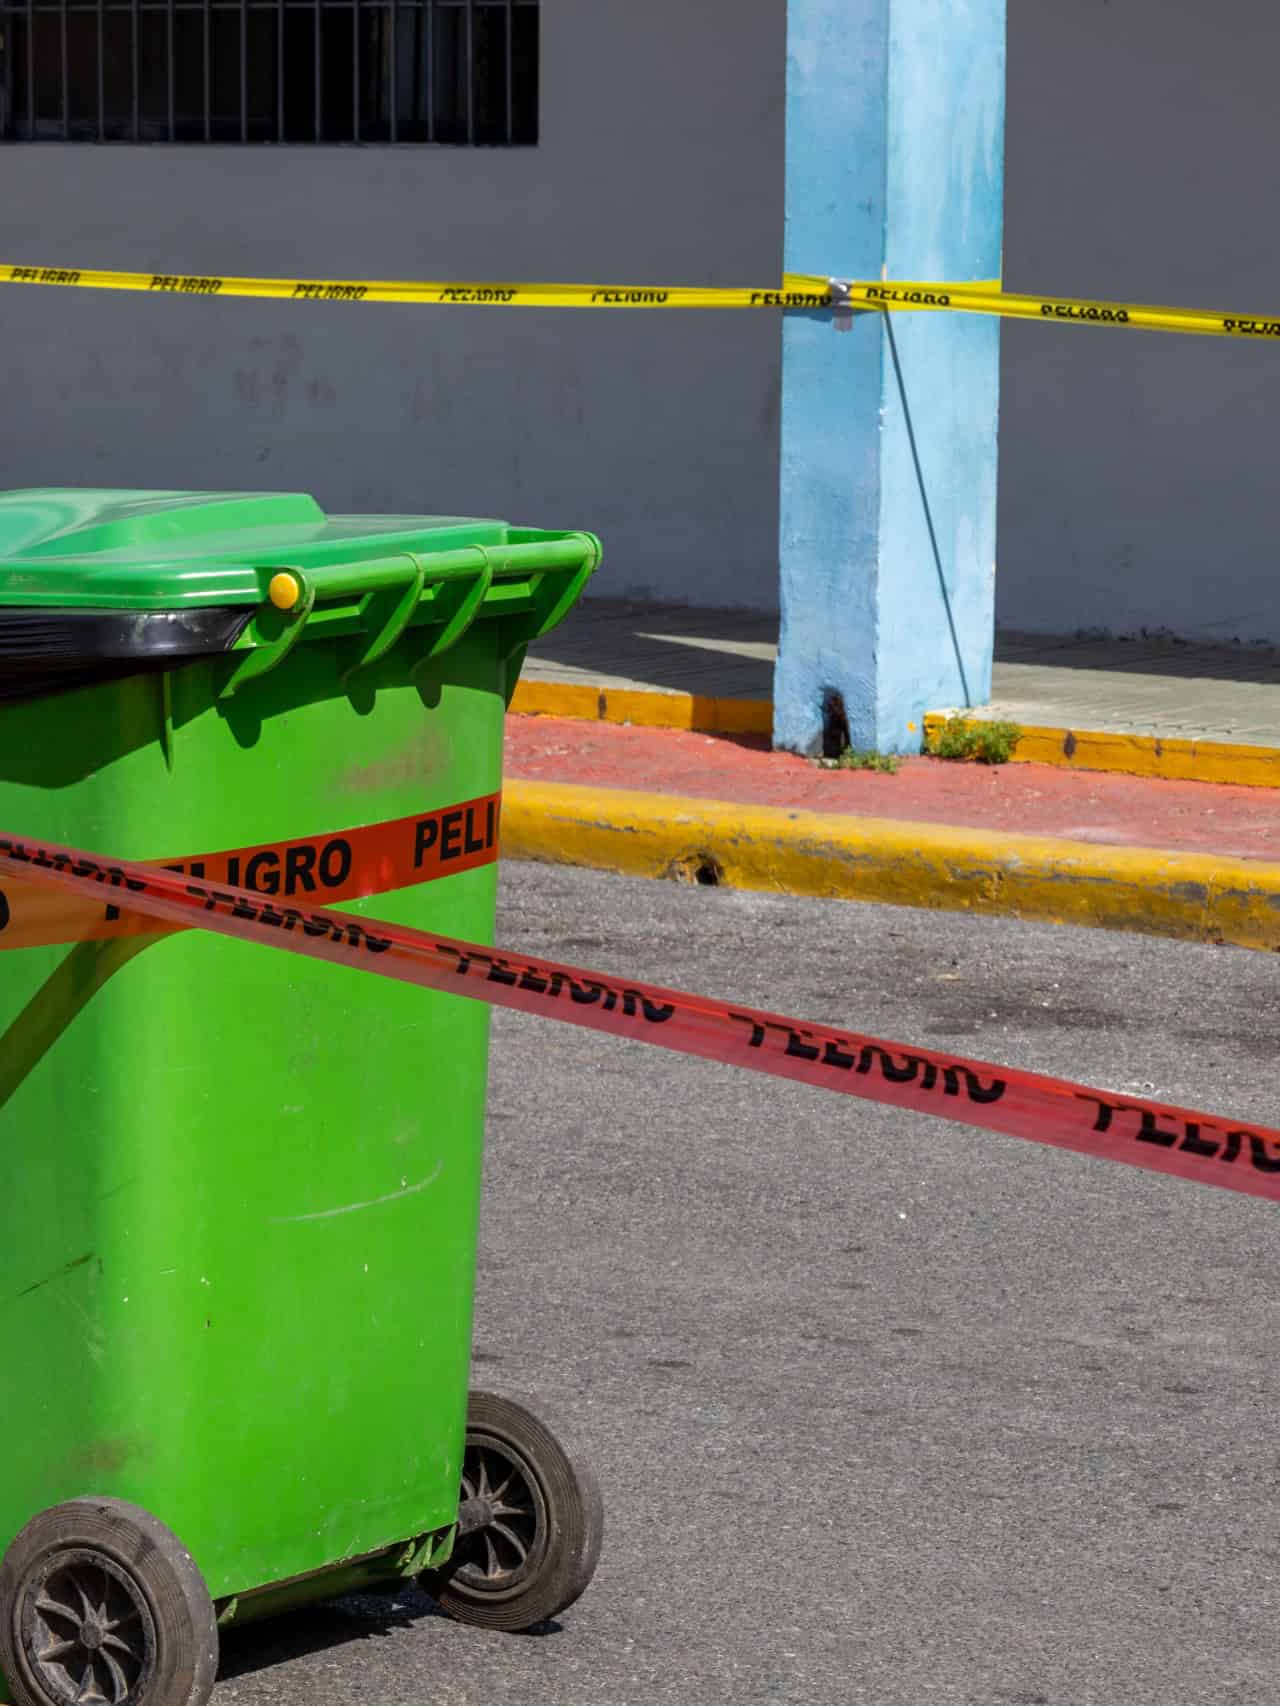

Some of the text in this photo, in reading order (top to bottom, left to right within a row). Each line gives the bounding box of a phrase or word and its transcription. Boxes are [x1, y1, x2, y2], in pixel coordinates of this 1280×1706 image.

[10, 267, 80, 285] PELIGRO
[149, 275, 222, 295] PELIGRO
[293, 283, 368, 301] PELIGRO
